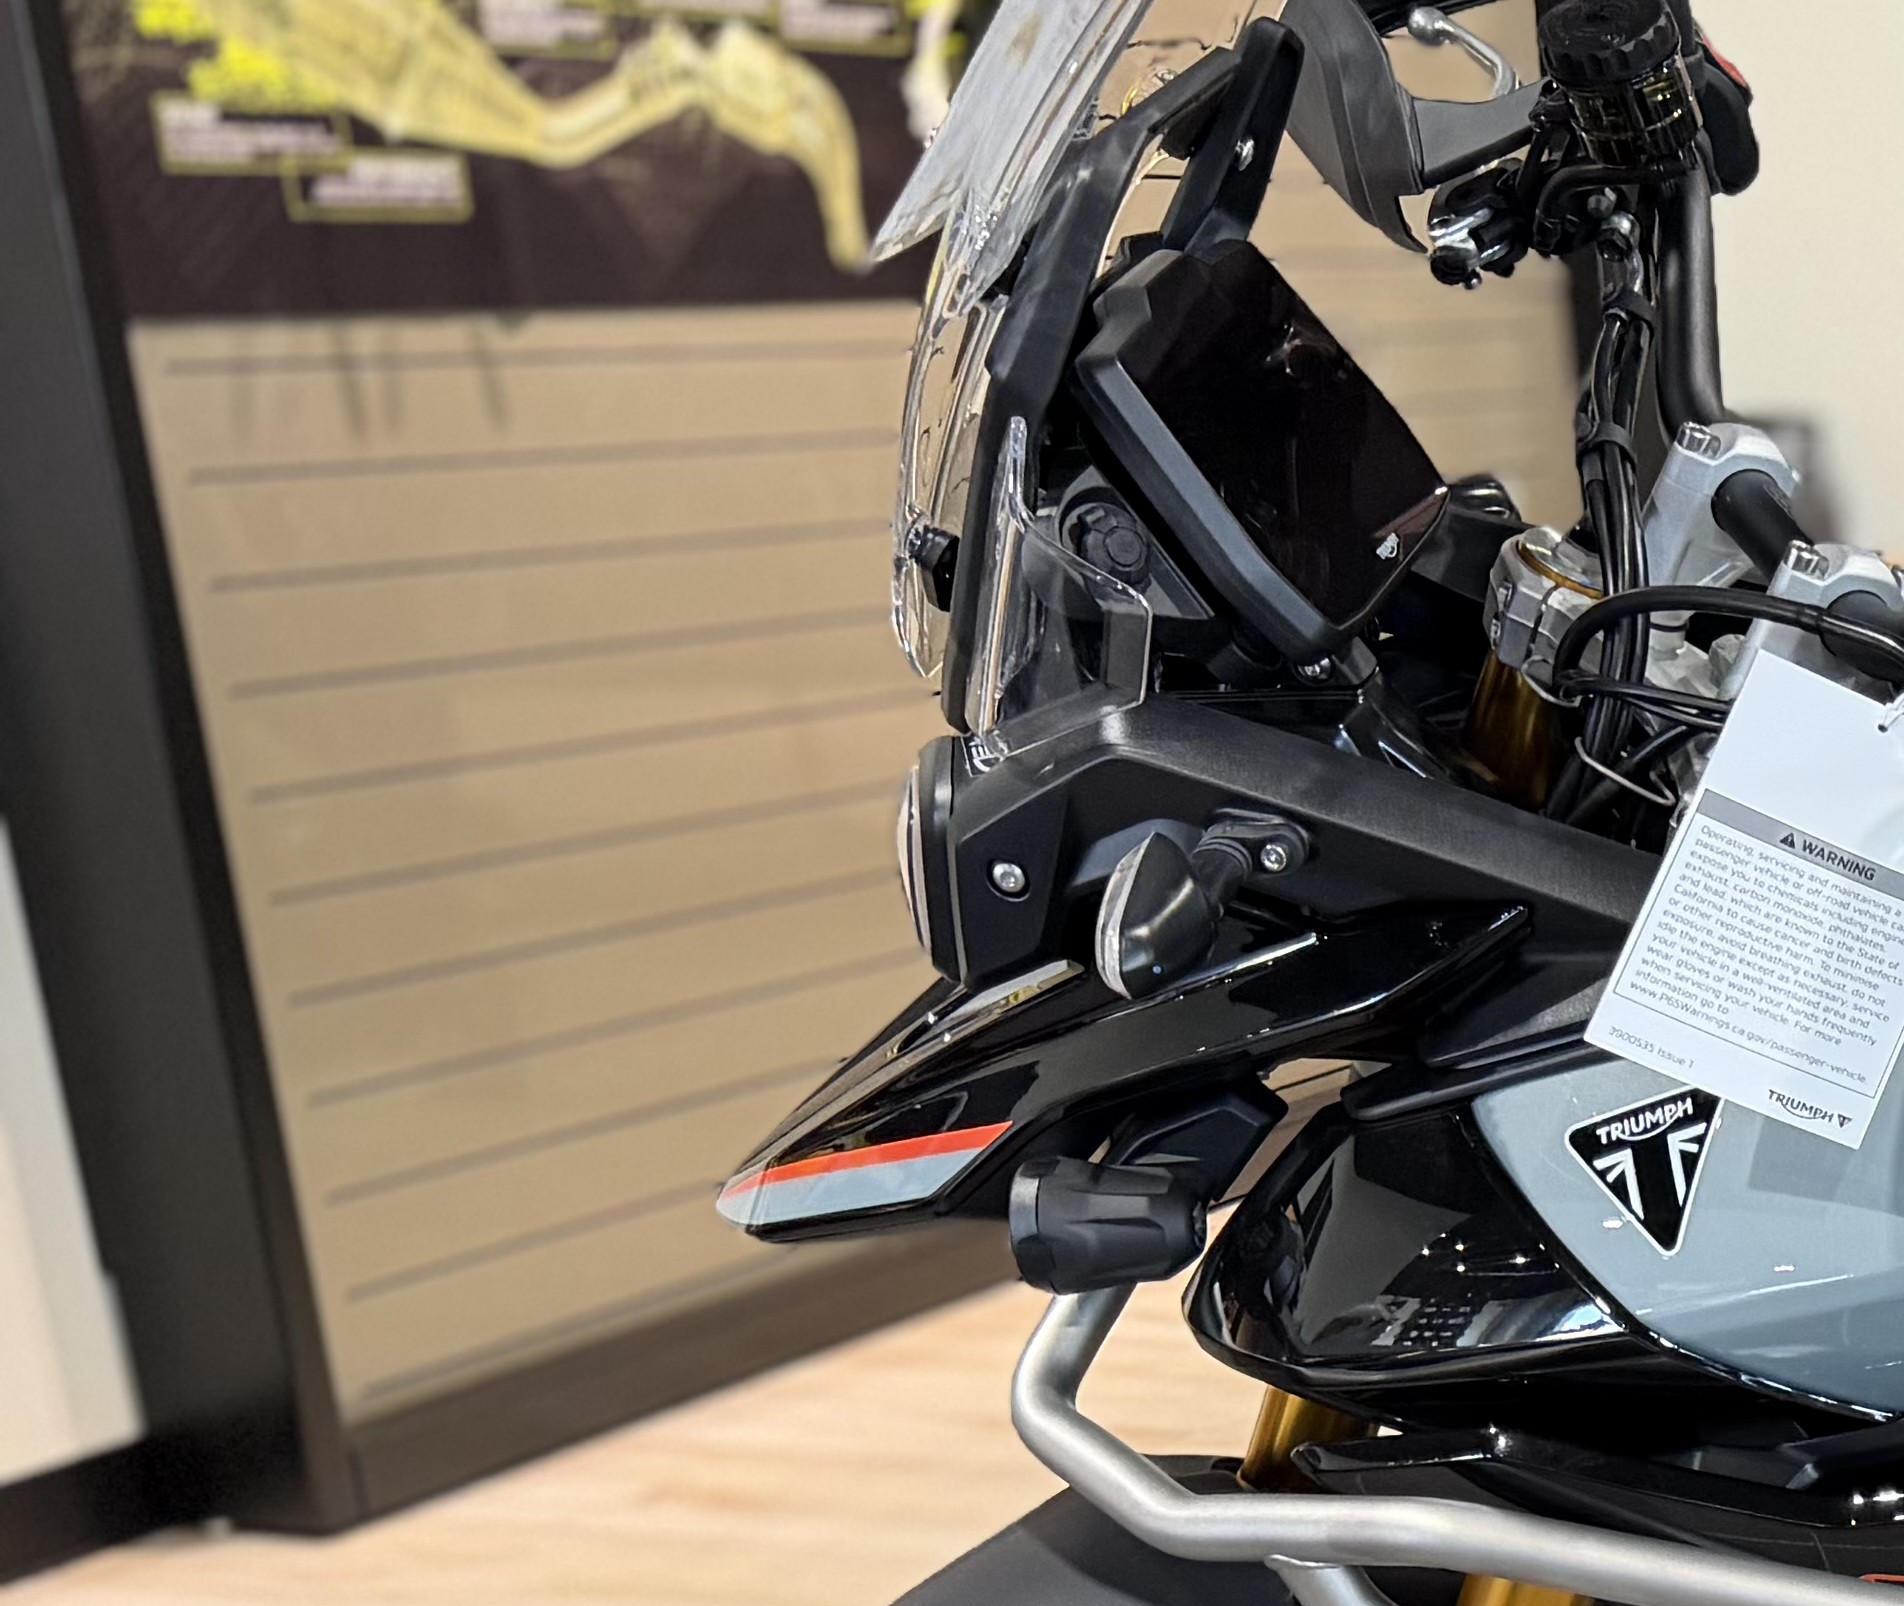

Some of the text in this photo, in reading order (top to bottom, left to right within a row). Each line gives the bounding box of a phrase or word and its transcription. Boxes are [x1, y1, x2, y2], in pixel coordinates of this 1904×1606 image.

[1689, 849, 1729, 873] expose
[1730, 867, 1752, 883] you
[1766, 884, 1819, 913] chemicals
[1821, 907, 1870, 934] including
[1694, 838, 1752, 868] passenger
[1753, 863, 1791, 886] vehicle
[1806, 887, 1852, 911] off-road
[1852, 905, 1890, 926] vehicle
[1732, 883, 1772, 906] carbon
[1758, 851, 1806, 880] servicing
[1807, 873, 1830, 888] and
[1830, 883, 1893, 915] maintaining
[1801, 839, 1876, 883] WARNING
[1673, 883, 1724, 913] California
[1739, 915, 1773, 934] cause
[1773, 929, 1812, 949] cancer
[1812, 946, 1836, 960] and
[1835, 952, 1863, 971] birth
[1863, 965, 1904, 987] defects
[1678, 873, 1702, 889] and
[1730, 895, 1762, 916] which
[1762, 910, 1783, 924] are
[1784, 917, 1820, 940] known
[1836, 939, 1856, 954] the
[1856, 946, 1886, 966] State
[1682, 903, 1713, 922] other
[1714, 917, 1784, 953] reproductive
[1635, 969, 1699, 1002] information
[1641, 957, 1672, 977] when
[1673, 971, 1723, 1000] servicing
[1723, 992, 1751, 1009] your
[1793, 1019, 1813, 1034] For
[1813, 1029, 1842, 1046] more
[1646, 944, 1674, 962] wear
[1675, 957, 1711, 980] gloves
[1727, 980, 1757, 998] wash
[1758, 992, 1784, 1009] your
[1785, 1003, 1820, 1024] hands
[1821, 1016, 1878, 1047] frequently
[1651, 933, 1678, 949] your
[1680, 944, 1718, 968] vehicle
[1742, 972, 1822, 1011] well-ventilated
[1821, 1005, 1847, 1021] area
[1848, 1015, 1871, 1030] and
[1657, 920, 1678, 935] idle
[1678, 929, 1699, 945] the
[1699, 939, 1738, 962] engine
[1738, 956, 1776, 978] except
[1851, 1002, 1890, 1023] service
[1716, 933, 1748, 952] avoid
[1748, 944, 1802, 976] breathing
[1867, 994, 1886, 1008] not
[1656, 1046, 1687, 1066] Issue
[1596, 1097, 1694, 1144] TRIUMPH
[1768, 1088, 1835, 1123] TRIUMPH
